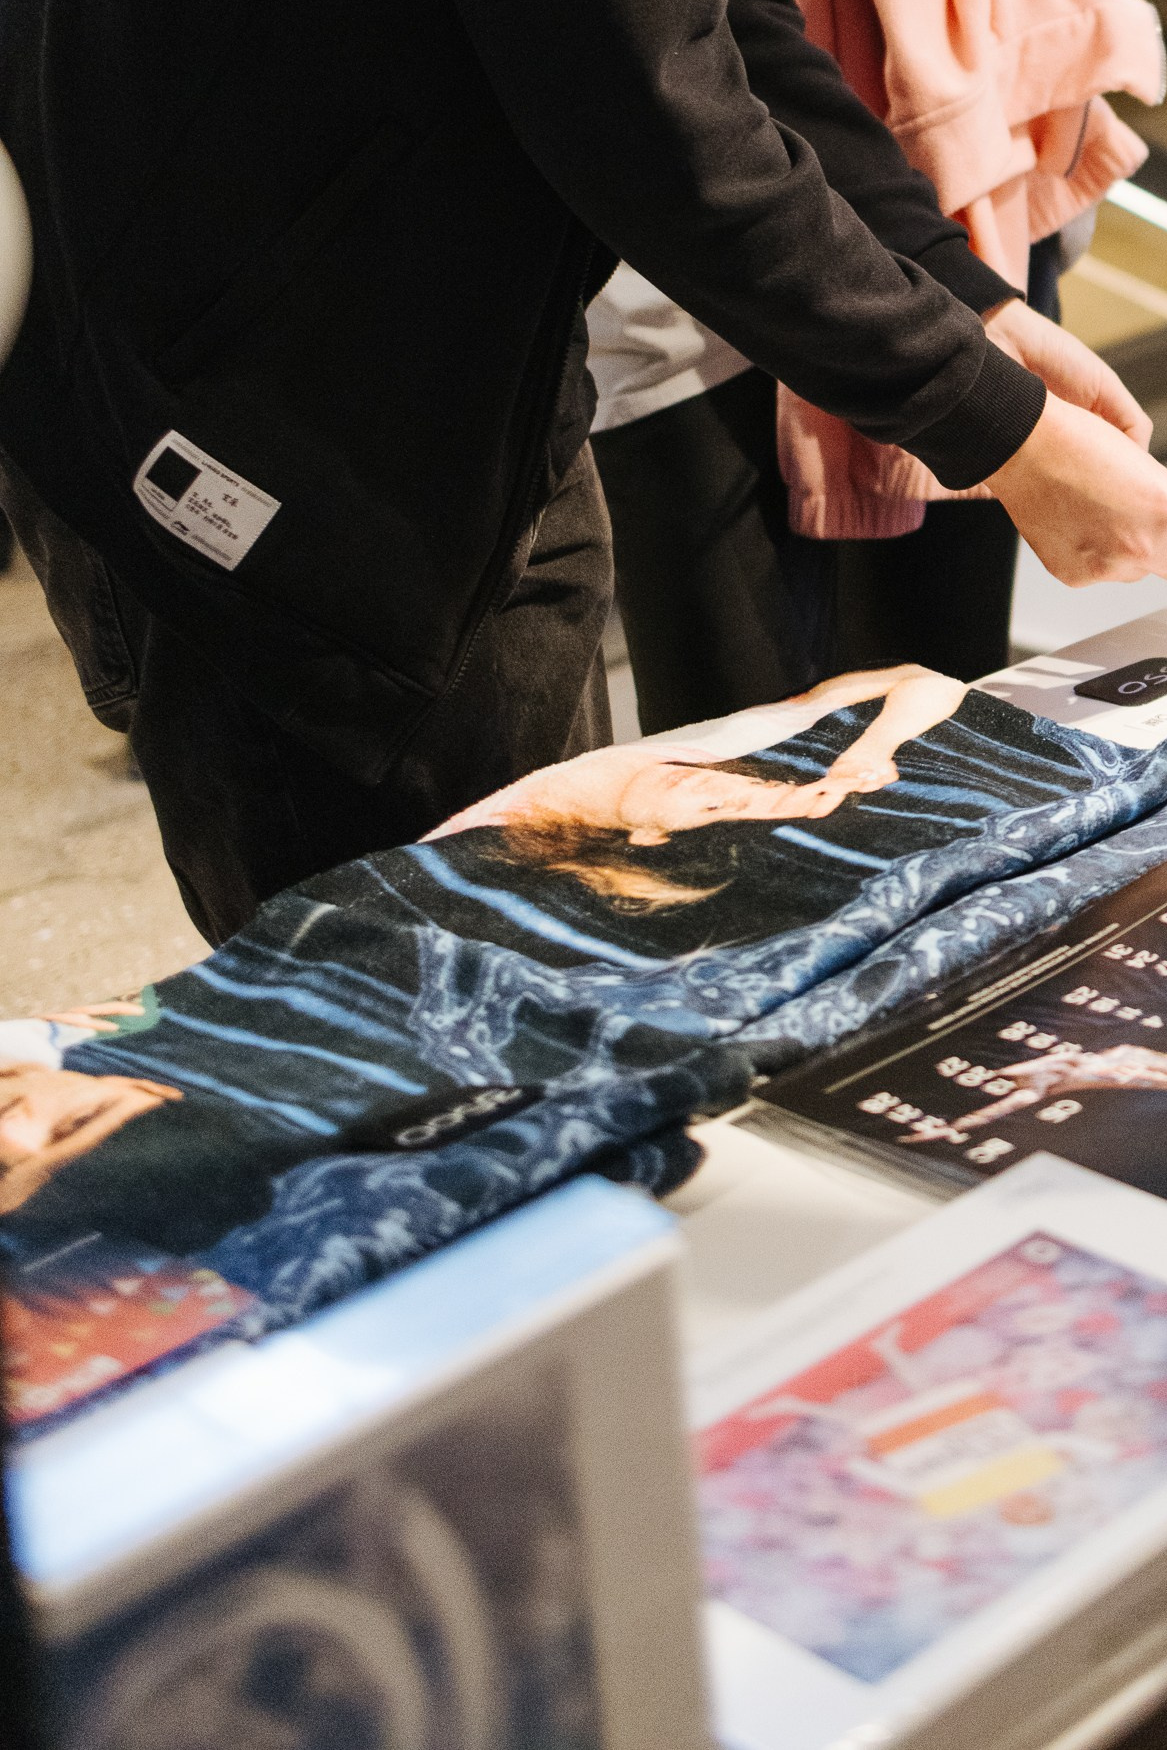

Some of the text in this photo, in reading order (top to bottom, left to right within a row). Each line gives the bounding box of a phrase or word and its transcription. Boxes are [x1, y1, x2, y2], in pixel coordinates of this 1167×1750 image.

[1102, 943, 1134, 960] 31
[1123, 949, 1160, 969] 24
[1139, 1014, 1164, 1029] 4
[954, 1065, 997, 1087] 20
[1035, 1099, 1083, 1124] СБ
